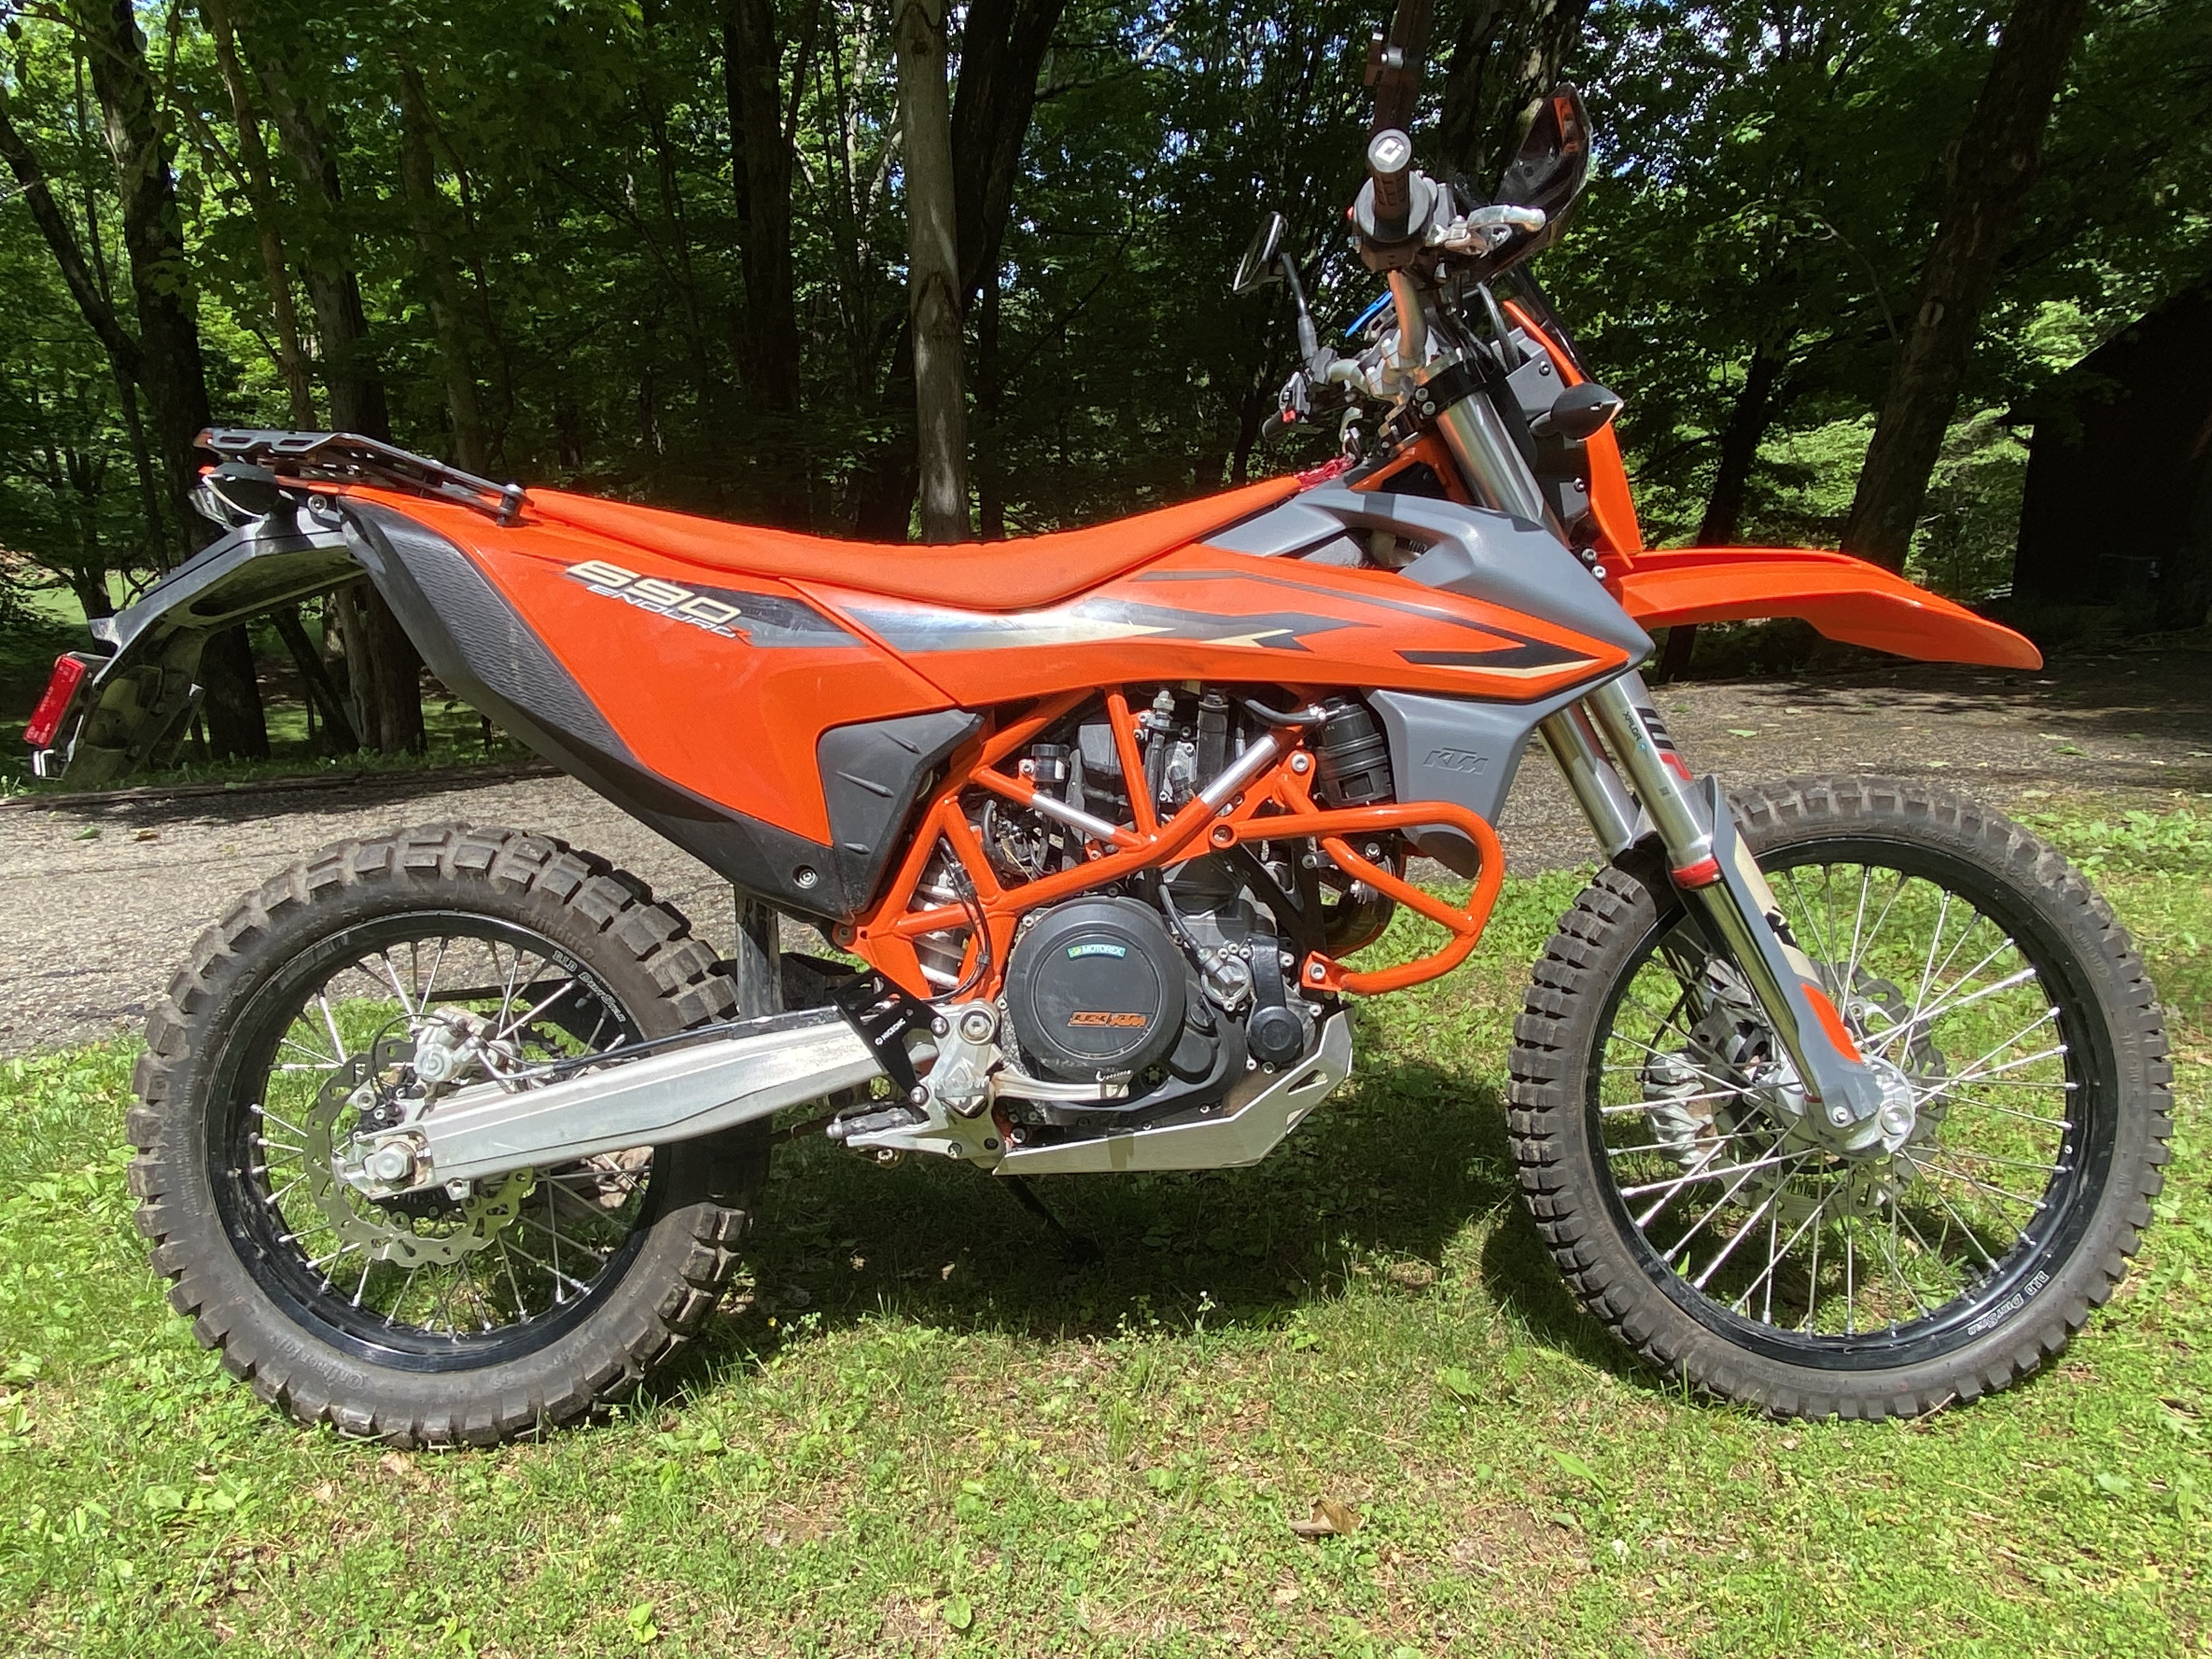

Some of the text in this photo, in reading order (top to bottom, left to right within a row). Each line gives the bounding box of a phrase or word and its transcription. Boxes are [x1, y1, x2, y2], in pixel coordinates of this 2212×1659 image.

[566, 560, 742, 624] 690
[586, 584, 736, 637] ENDURO
[1423, 747, 1489, 775] KTM
[1081, 944, 1122, 955] MOTOREX
